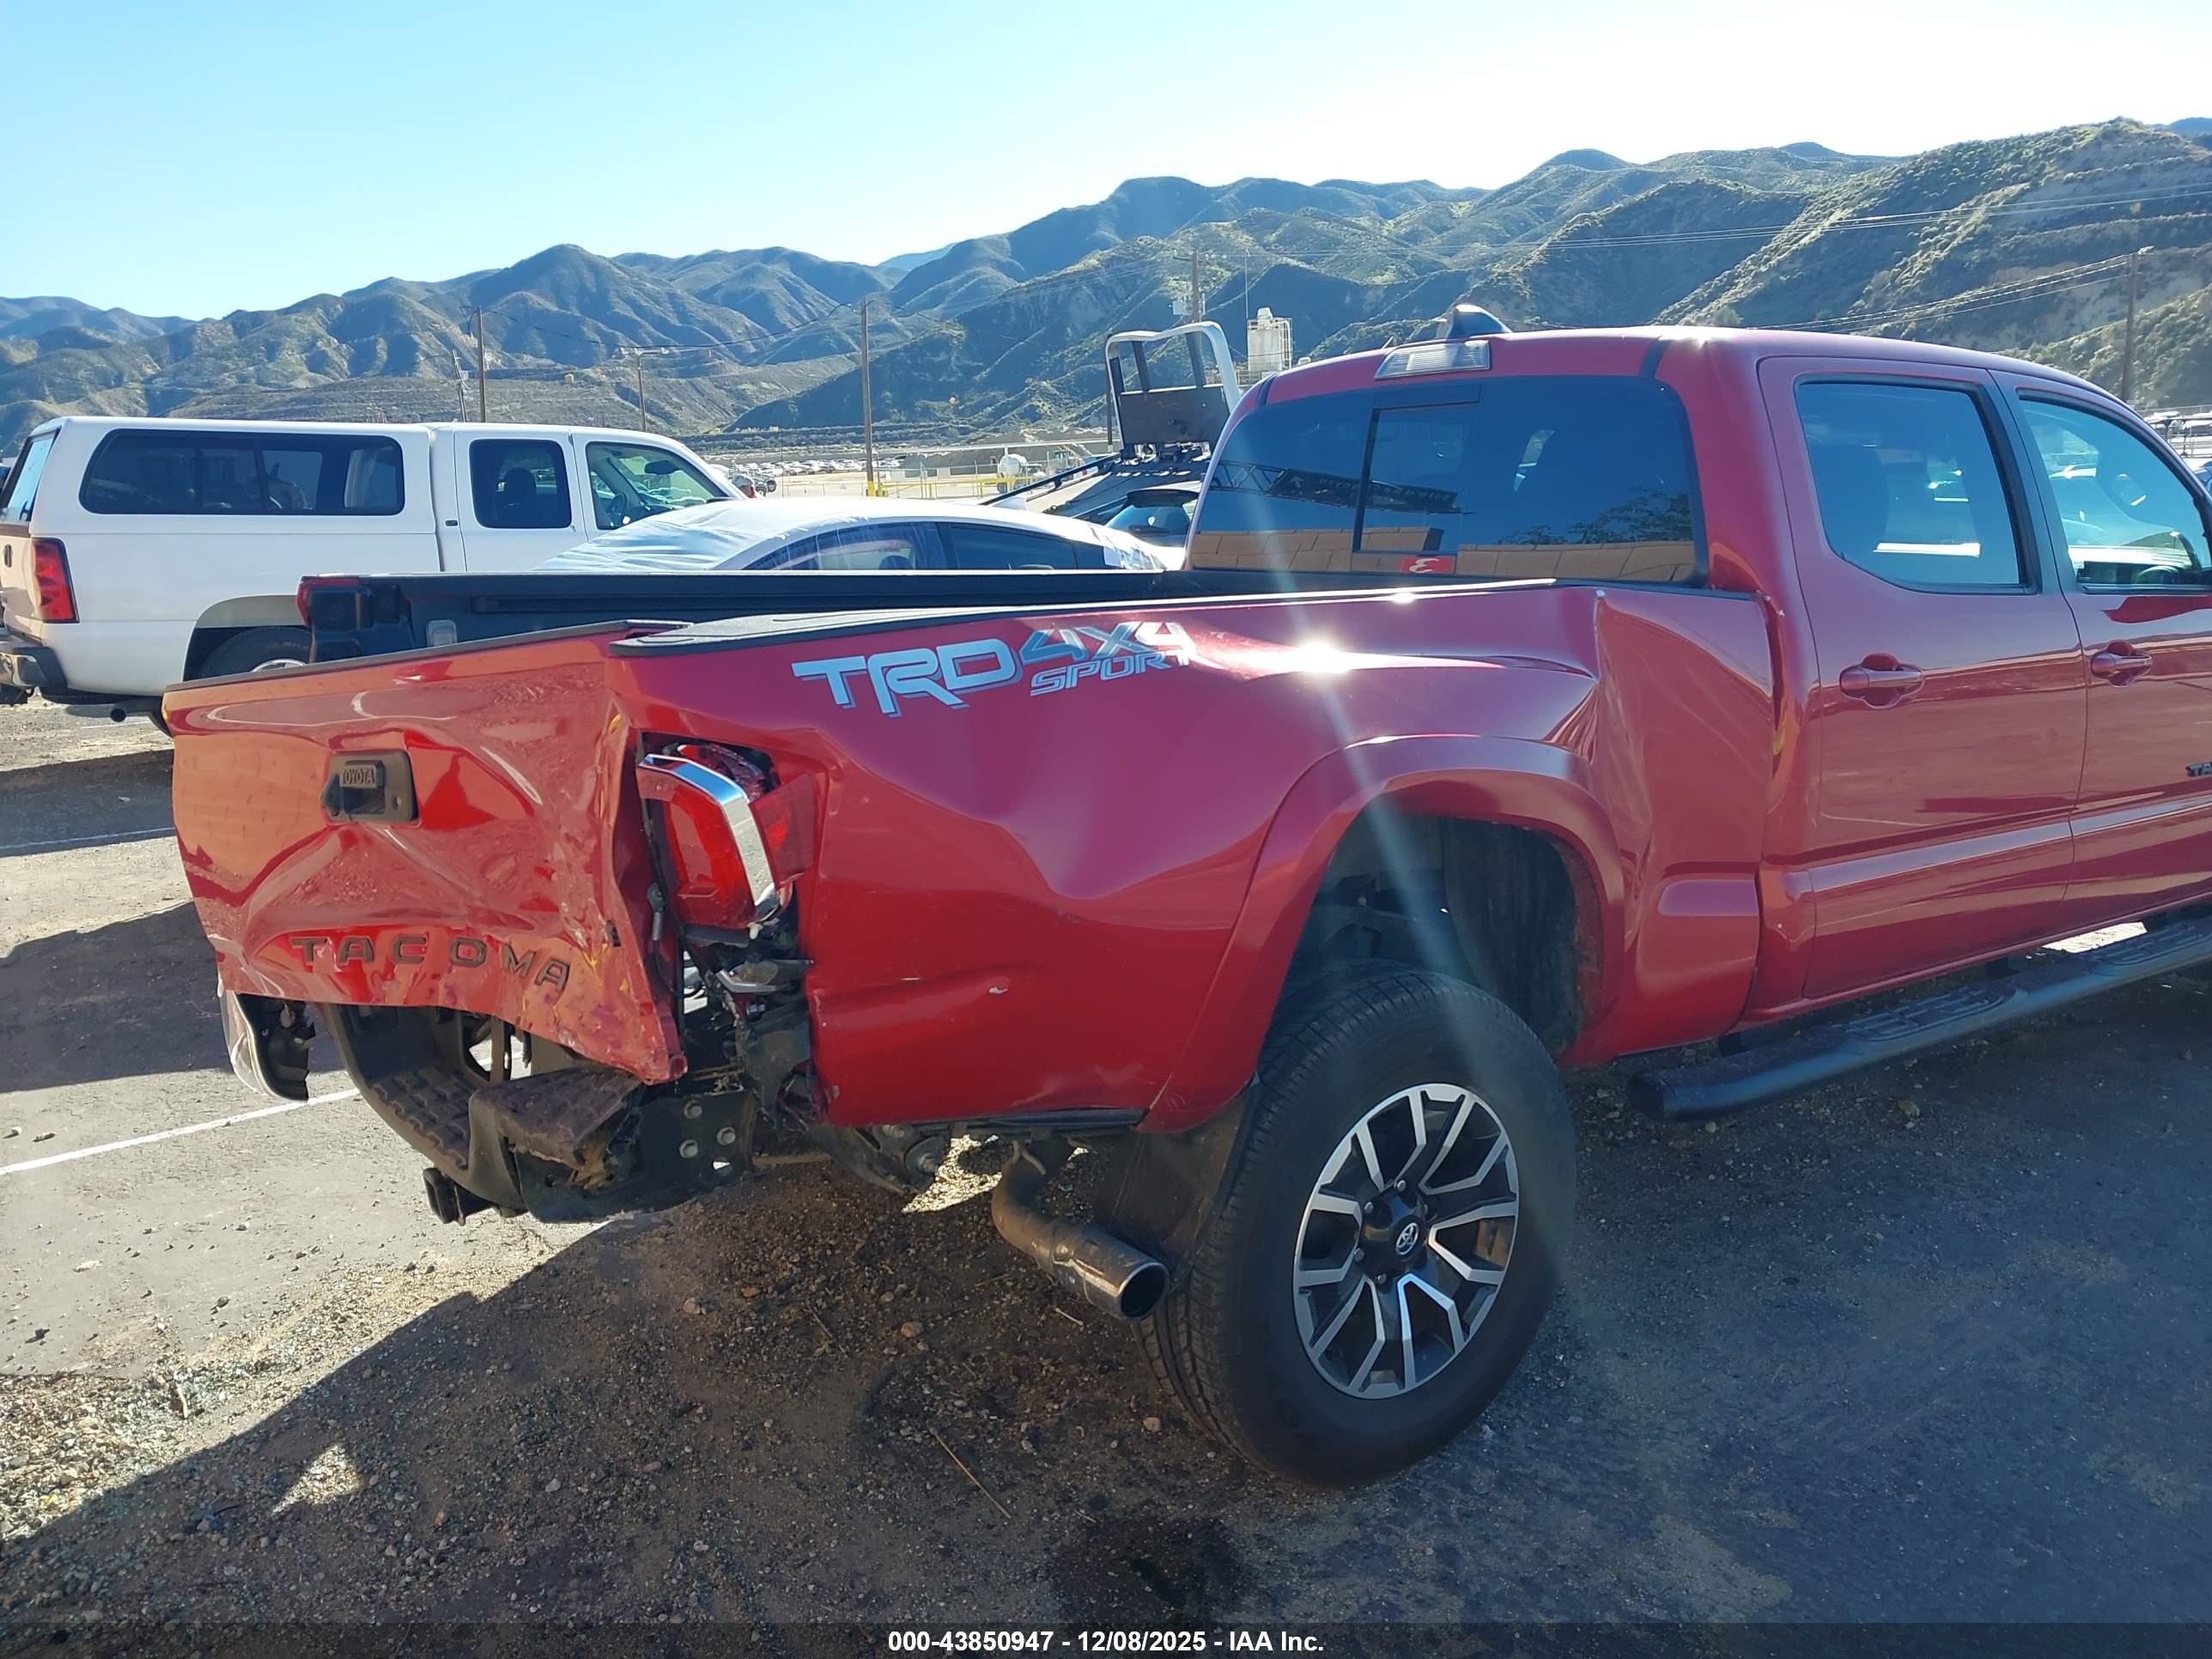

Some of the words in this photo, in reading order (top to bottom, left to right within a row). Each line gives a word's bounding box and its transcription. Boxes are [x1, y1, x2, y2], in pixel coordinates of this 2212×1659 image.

[790, 635, 1023, 718] TRD
[1030, 650, 1191, 697] SPORT
[342, 768, 376, 785] TOYOTA
[289, 936, 572, 992] TACOMA
